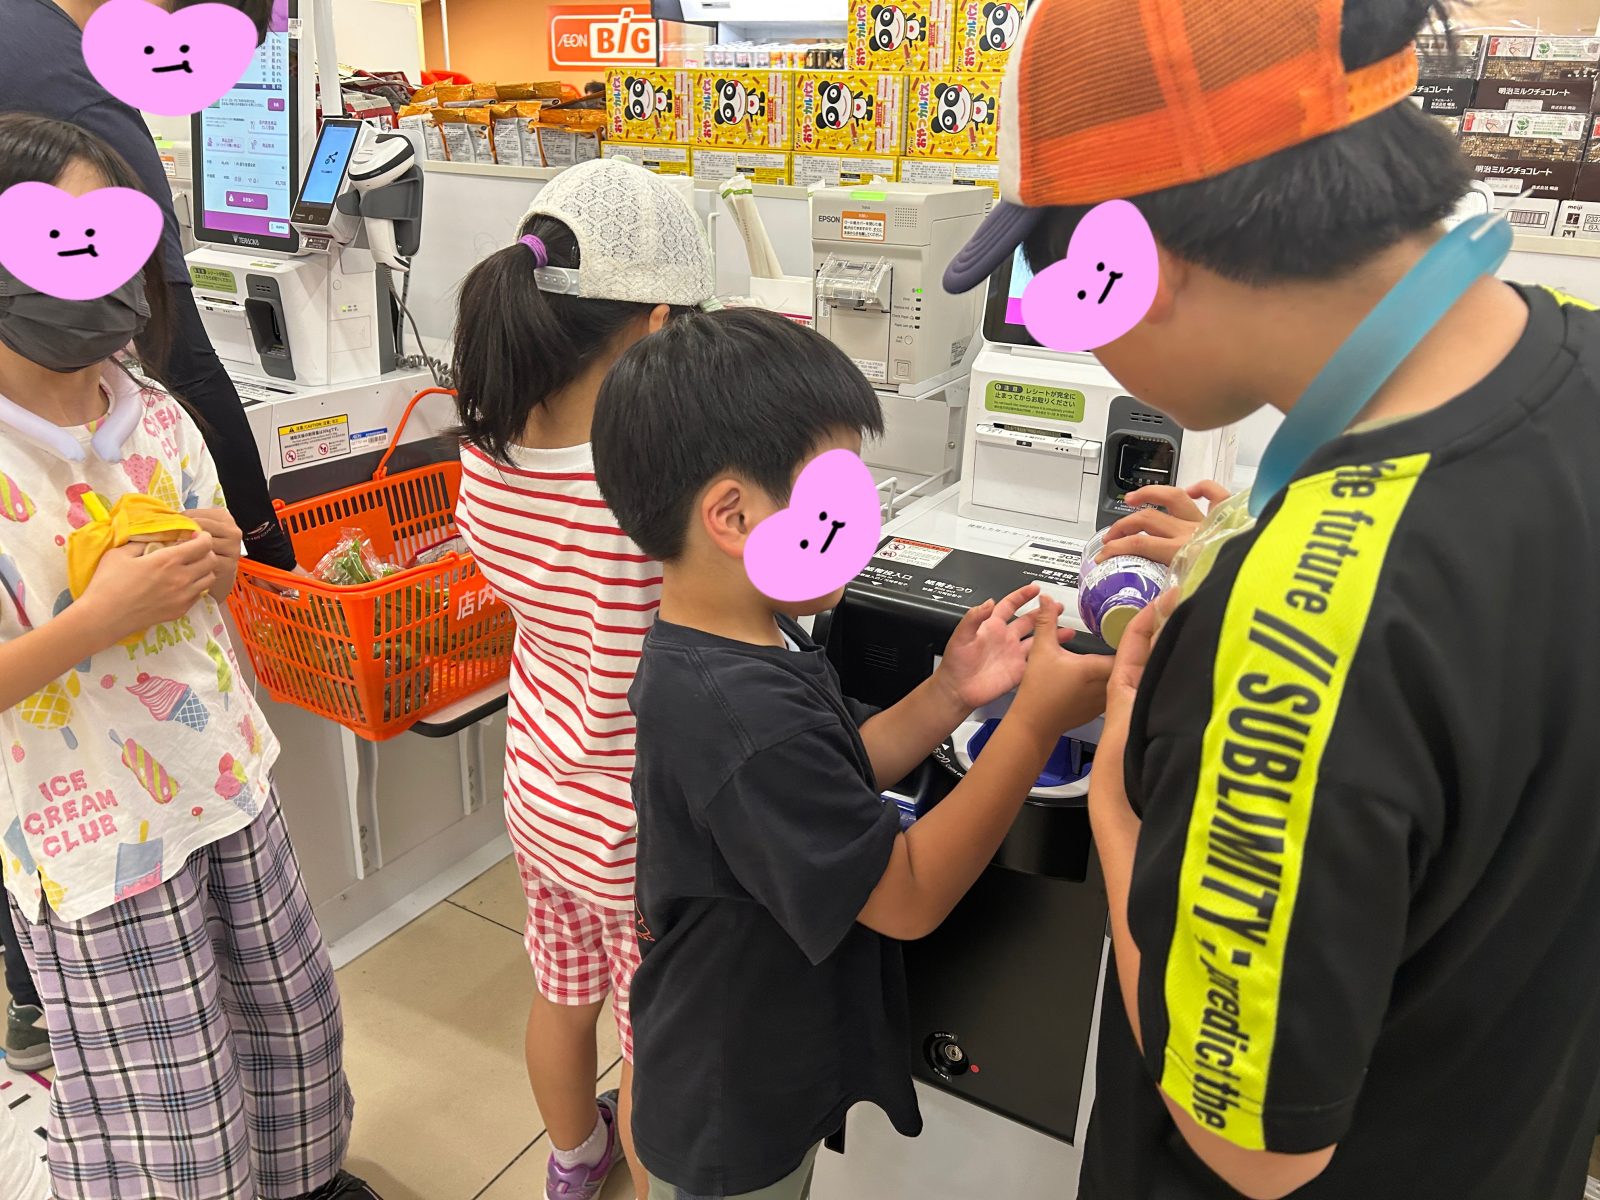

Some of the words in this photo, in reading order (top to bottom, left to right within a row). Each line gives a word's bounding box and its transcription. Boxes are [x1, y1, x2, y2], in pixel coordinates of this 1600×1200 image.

[856, 4, 867, 66] おやつカルパス
[963, 2, 978, 67] おやつカルパス
[612, 75, 623, 133] おやつカルパス
[702, 78, 712, 138] おやつカルパス
[803, 80, 813, 143] おやつカルパス
[1498, 87, 1570, 96] 明治ミルクチョコレート
[916, 83, 929, 148] おやつカルパス
[1475, 164, 1552, 176] 明治ミルクチョコレート
[818, 215, 840, 223] EPSON
[994, 392, 1076, 407] 止まってからお取りください
[1026, 388, 1076, 400] レシートが完全に
[864, 566, 912, 580] 紙幣投入口
[1285, 509, 1375, 615] future
[924, 579, 972, 594] 紙幣おつり
[38, 769, 88, 802] ICE
[23, 789, 119, 836] CREAM
[42, 814, 118, 858] CLUB
[1195, 955, 1251, 1082] predict
[1192, 1072, 1241, 1131] the
